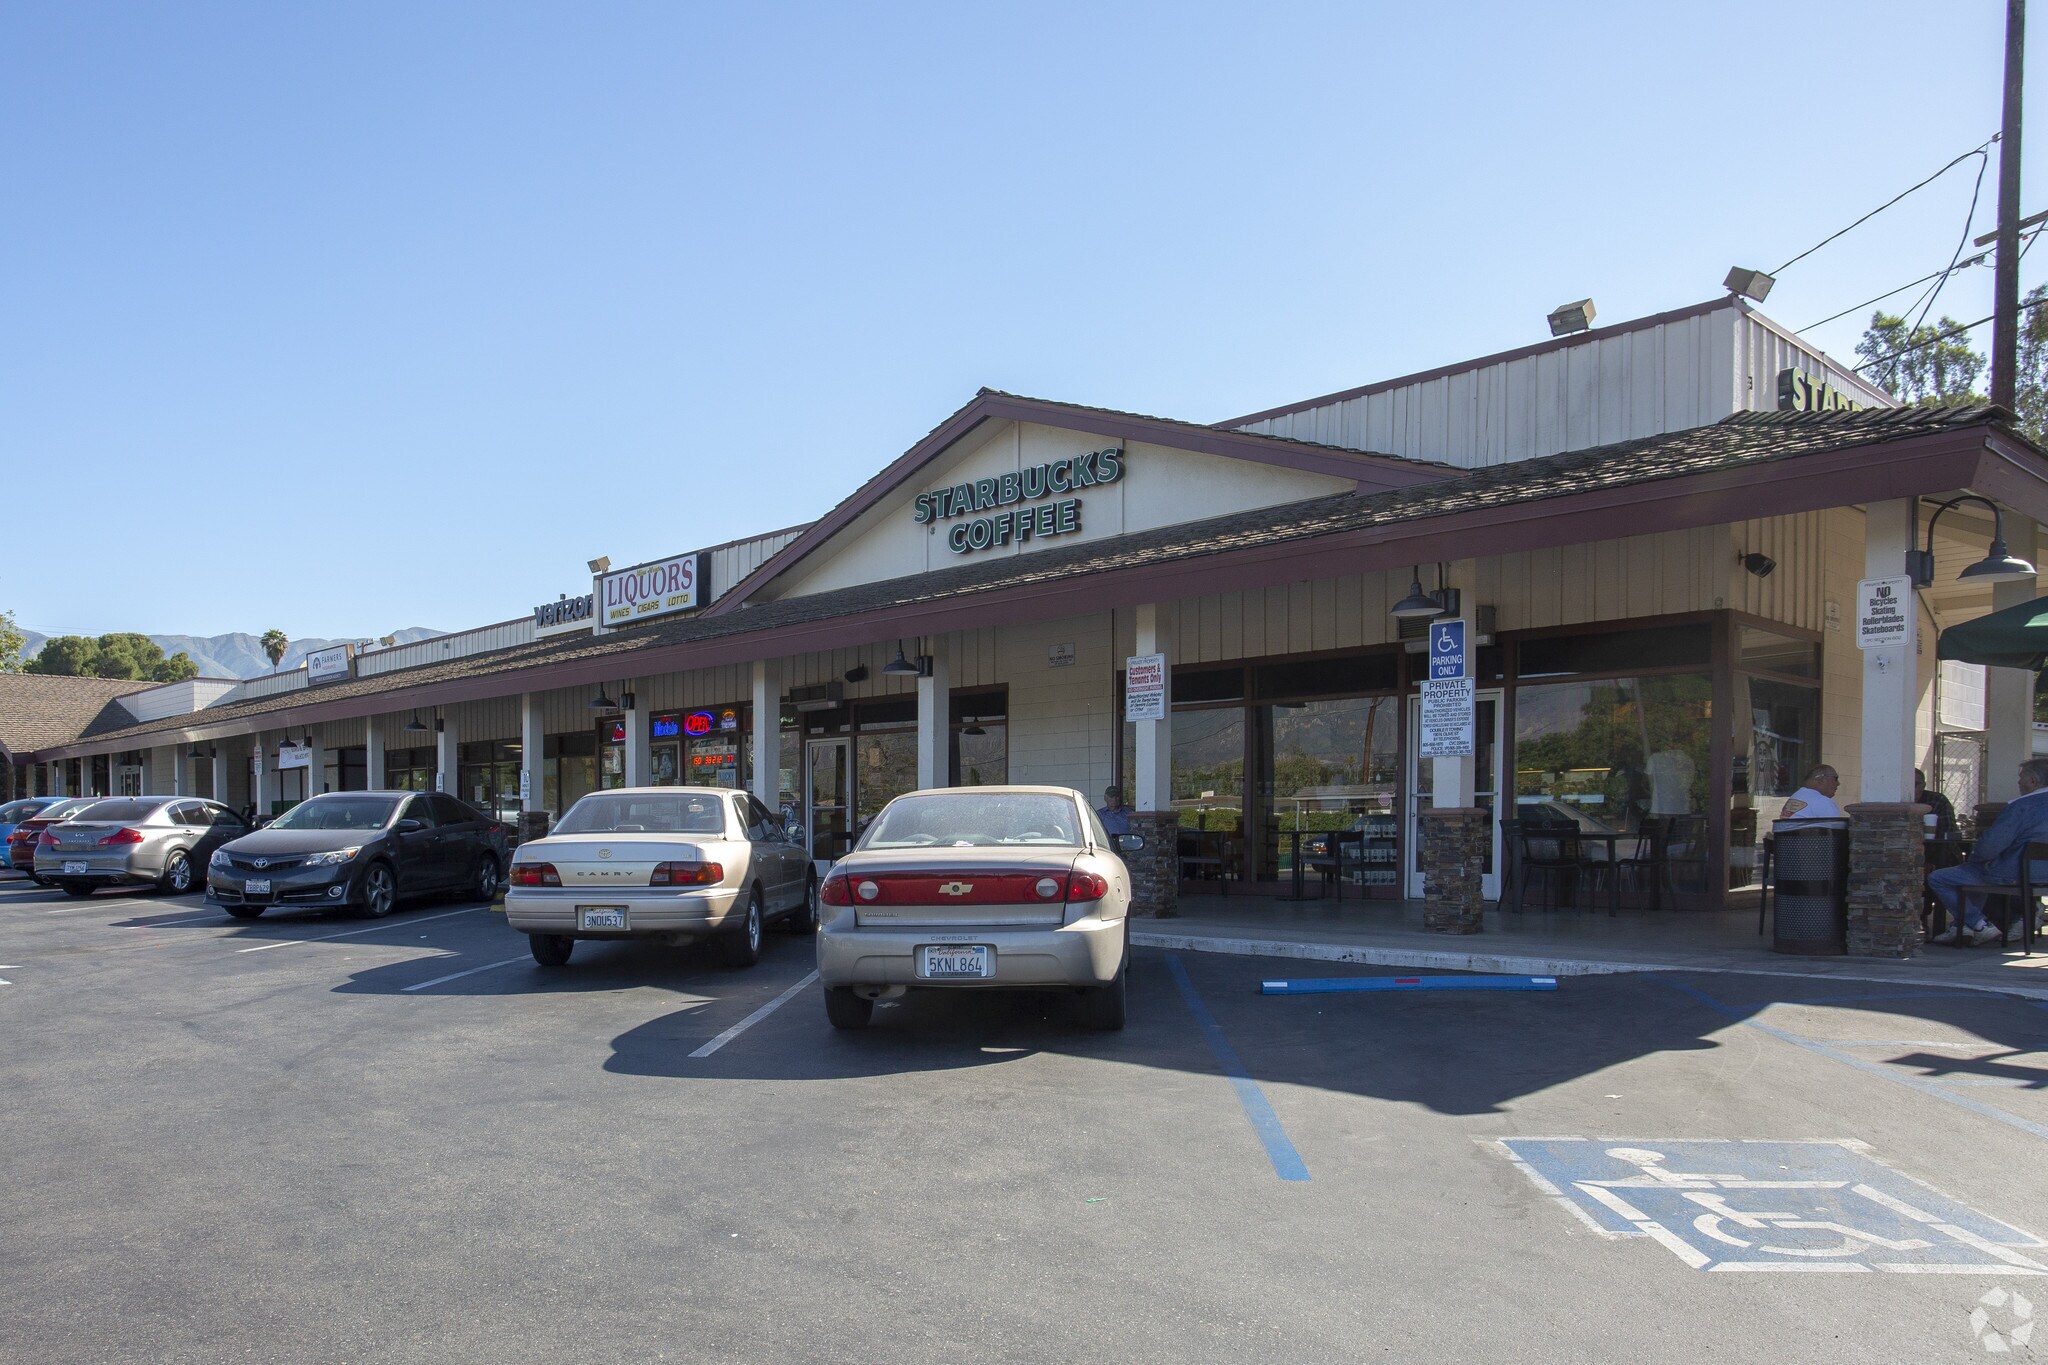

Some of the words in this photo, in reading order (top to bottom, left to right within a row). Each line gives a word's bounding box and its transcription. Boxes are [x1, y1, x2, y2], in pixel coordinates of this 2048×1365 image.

[1780, 367, 1863, 412] STA
[913, 447, 1122, 525] STARBUCKS
[949, 498, 1081, 554] COFFEE
[607, 559, 693, 607] LIQUORS
[1876, 586, 1891, 598] NO
[610, 608, 630, 620] WINES
[637, 601, 660, 614] CIGARS
[667, 594, 689, 607] LOTTO
[1869, 597, 1898, 607] Bicycles
[533, 593, 593, 627] verizon
[1871, 606, 1896, 615] Skating
[1862, 615, 1905, 625] Rollerblades
[1862, 624, 1905, 635] Skateboards
[321, 652, 342, 664] FARMERS
[1432, 654, 1462, 666] PARKING
[1129, 665, 1156, 676] Customers
[1157, 663, 1162, 672] &
[1438, 665, 1457, 676] ONLY
[1129, 675, 1150, 685] Tenants
[1150, 673, 1161, 684] Only
[1430, 680, 1467, 690] PRIVATE
[1423, 688, 1471, 699] PROPERTY
[687, 715, 709, 732] OPEN
[937, 947, 974, 957] California
[929, 957, 982, 972] 5KNL864
